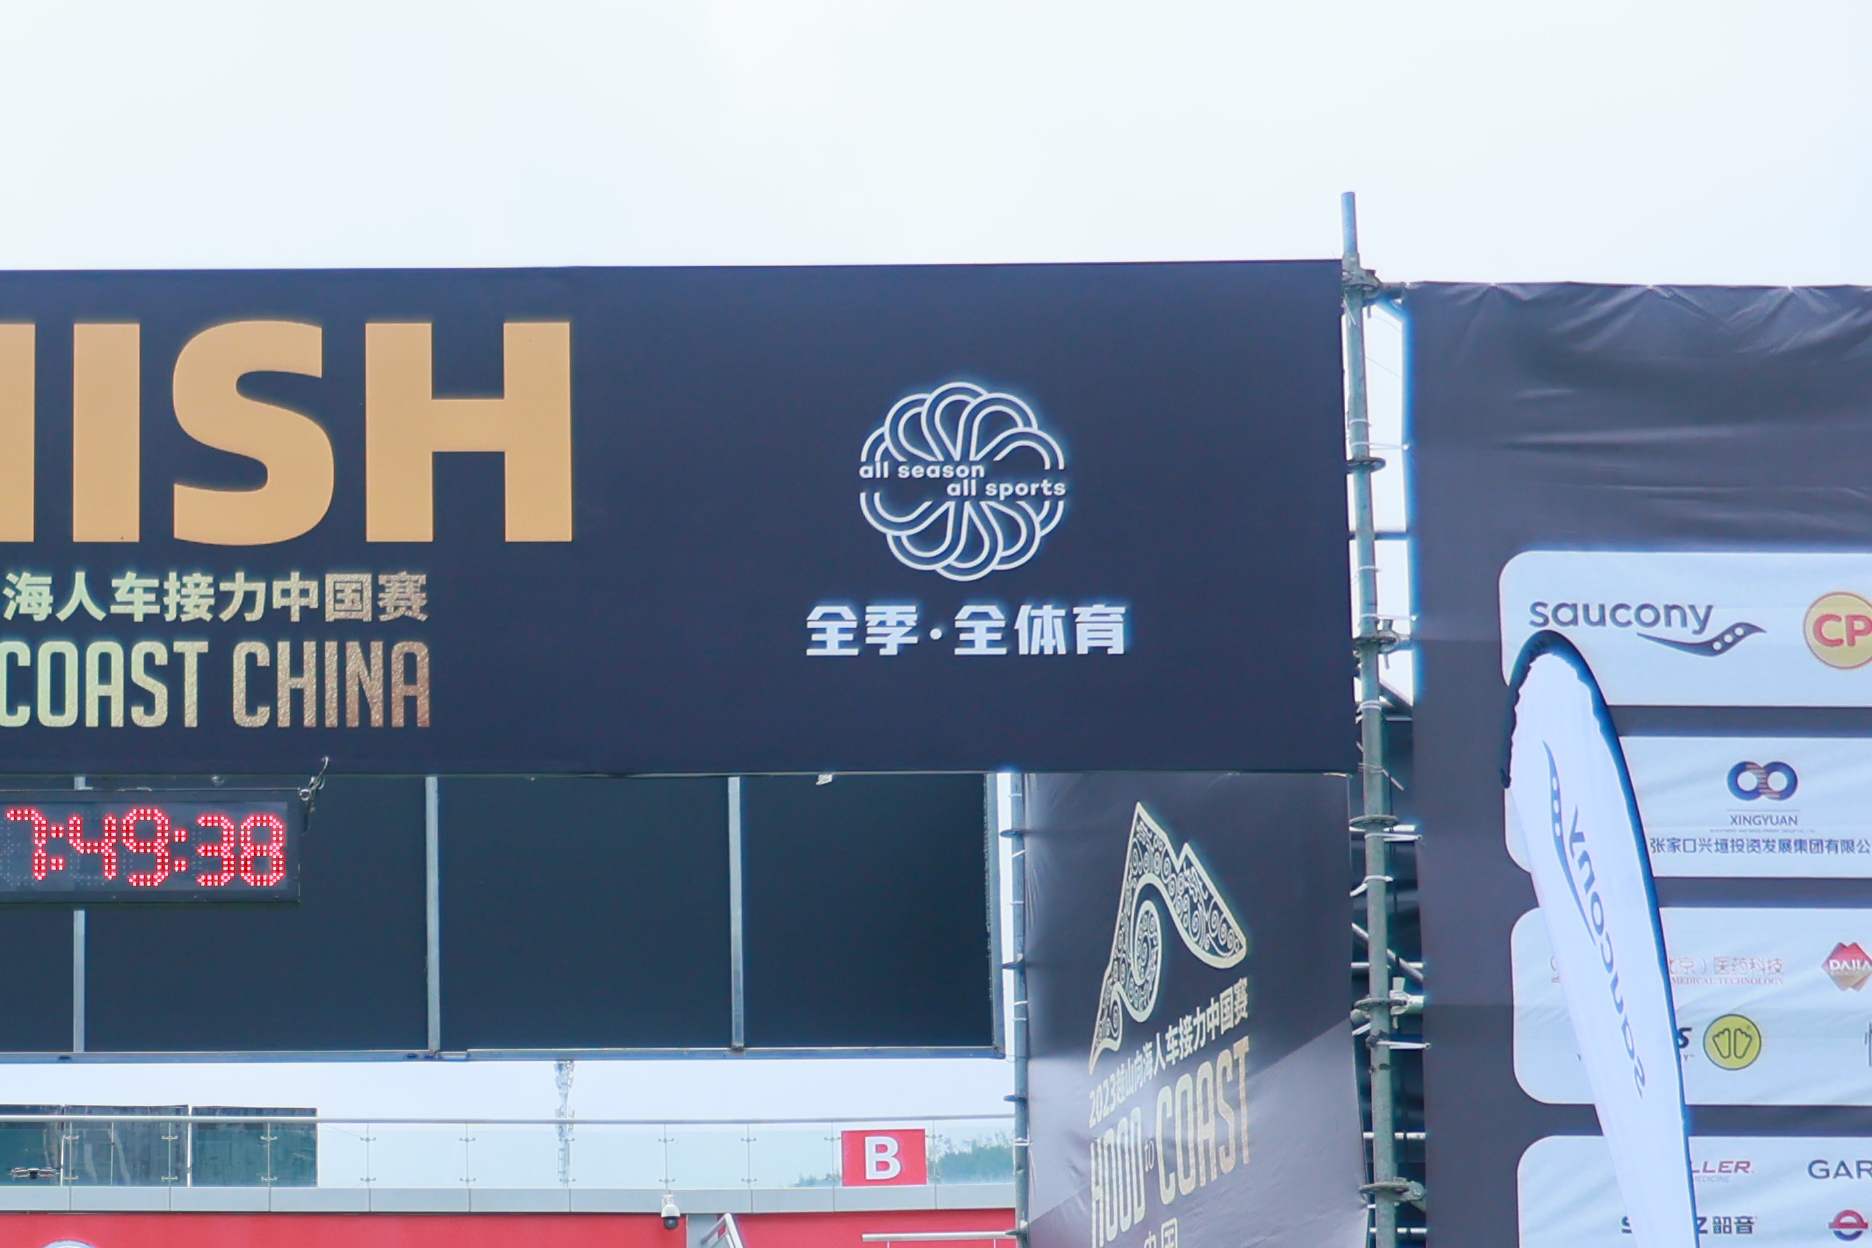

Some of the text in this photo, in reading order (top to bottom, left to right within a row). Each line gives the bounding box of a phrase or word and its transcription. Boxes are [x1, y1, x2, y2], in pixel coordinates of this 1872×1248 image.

[859, 461, 985, 479] all season
[946, 479, 1066, 500] all sports
[806, 605, 1126, 656] 全季·全体育
[1529, 601, 1714, 635] saucony
[1813, 614, 1872, 647] CP
[233, 640, 431, 728] CHINA
[1730, 815, 1798, 826] XINGYUAN
[1719, 977, 1784, 985] TECHNOLOGY
[1089, 977, 1248, 1128] 2023越山向海人车接力中国赛
[1144, 1138, 1155, 1173] to
[1157, 1035, 1250, 1204] COAST
[864, 1135, 901, 1180] B
[1713, 1216, 1755, 1235] 韶音
